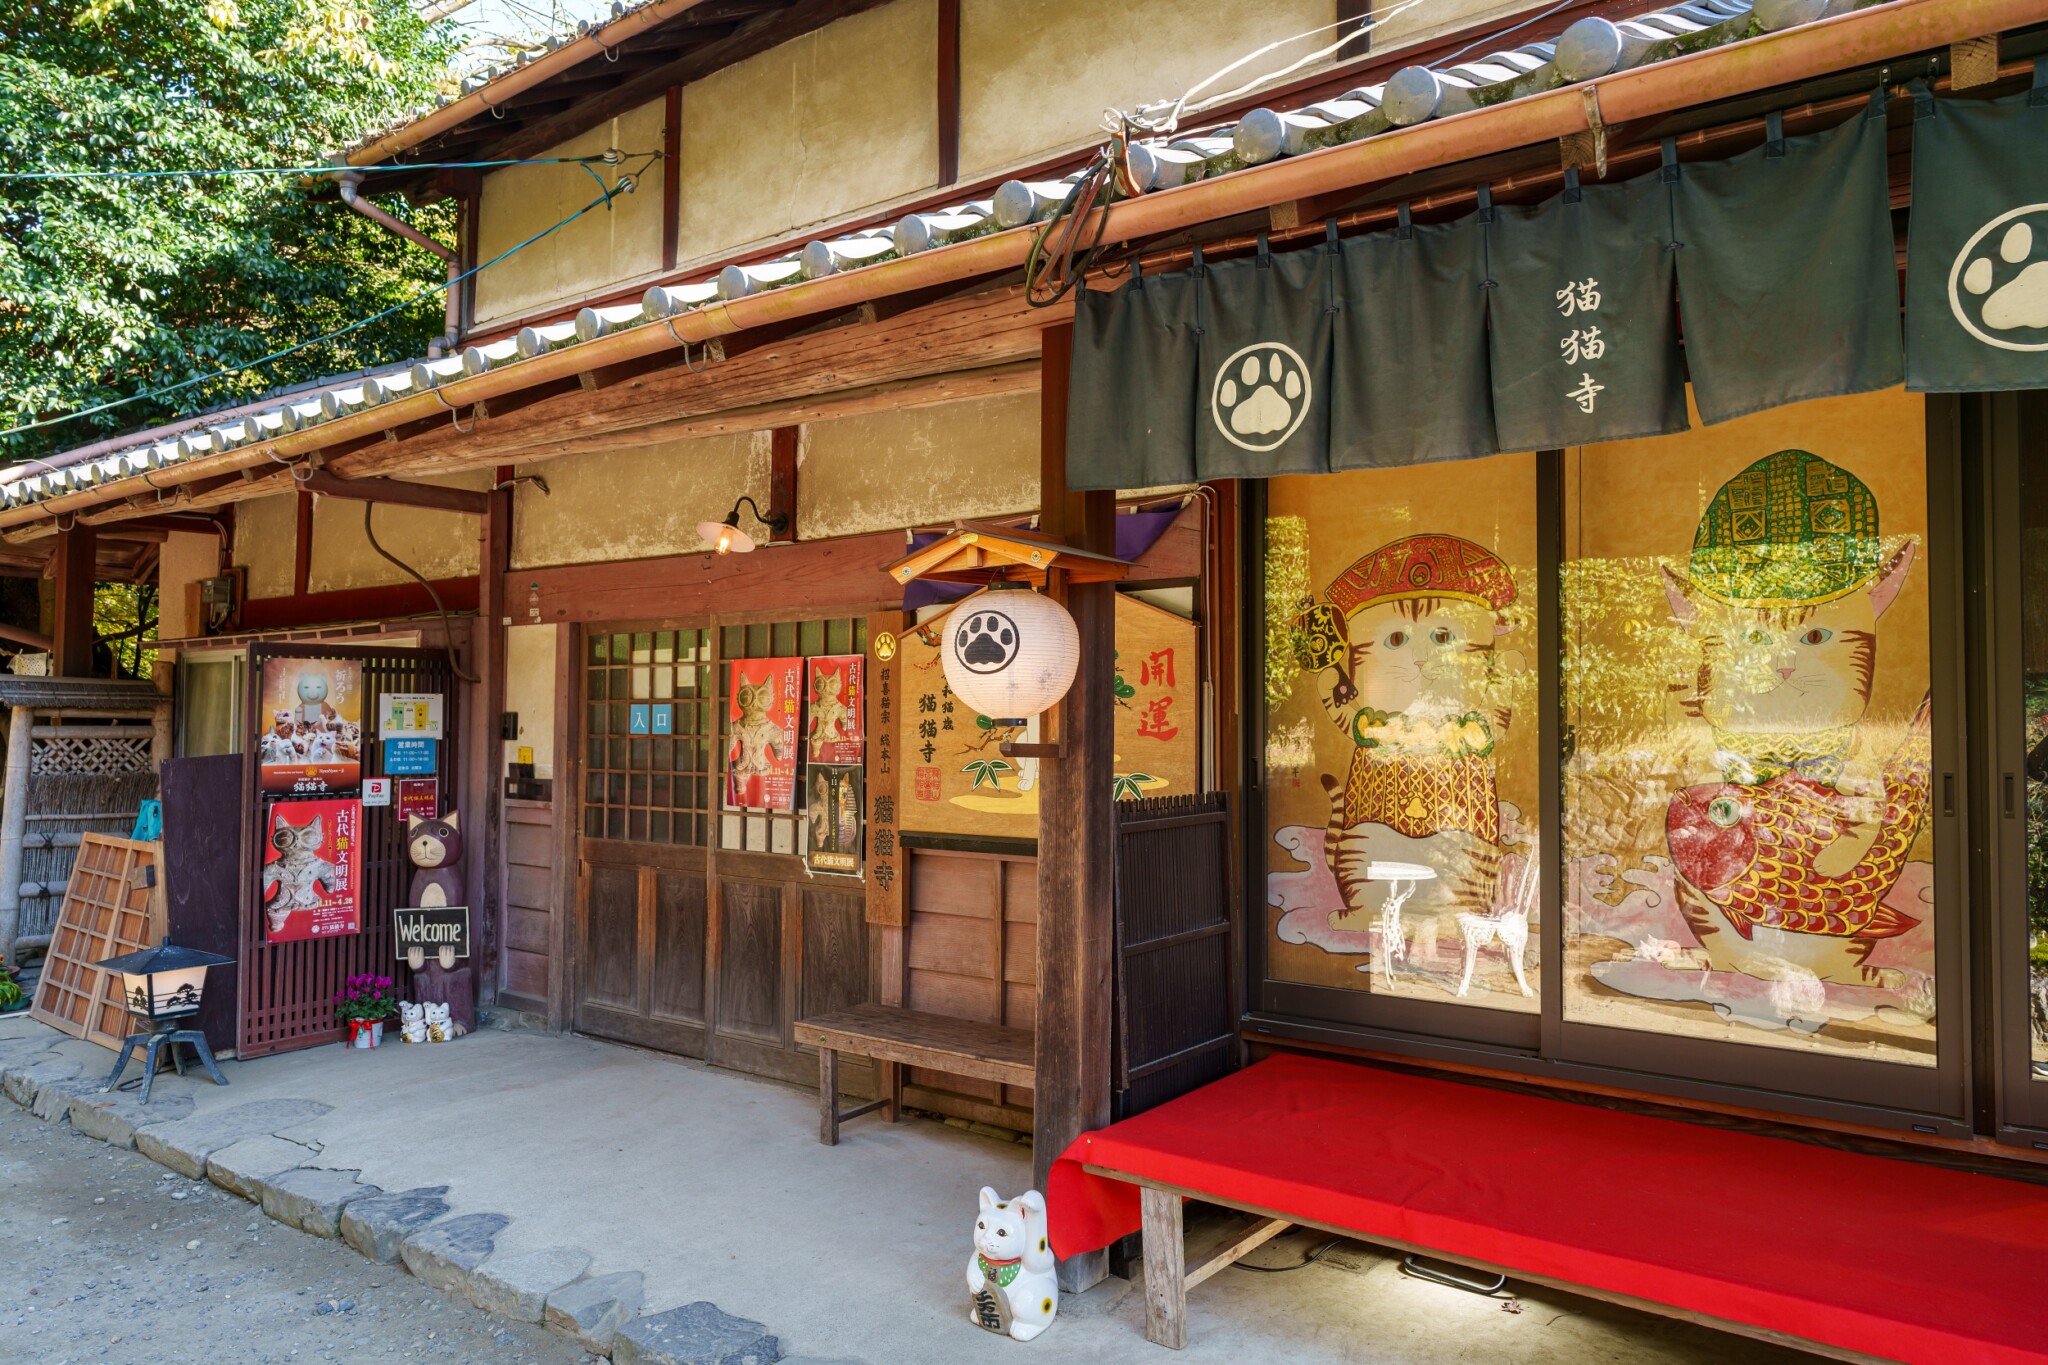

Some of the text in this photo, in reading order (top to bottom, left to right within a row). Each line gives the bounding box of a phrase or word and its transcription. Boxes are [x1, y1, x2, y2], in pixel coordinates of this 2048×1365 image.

[1556, 277, 1606, 414] 猫猫寺
[335, 669, 346, 704] 祈ろう
[633, 712, 667, 728] 入口
[783, 668, 795, 760] 古代猫文明展
[847, 662, 857, 730] 古代猫文明展
[880, 668, 891, 774] 招喜猫宗 総本山
[1137, 647, 1179, 742] 開運
[397, 741, 425, 749] 営業時間
[918, 693, 937, 764] 猫猫寺
[293, 781, 329, 792] 猫猫寺
[335, 809, 349, 892] 古代猫文明展
[813, 854, 855, 868] 古代猫文明展
[873, 795, 895, 892] 猫猫寺
[398, 914, 462, 943] Welcome
